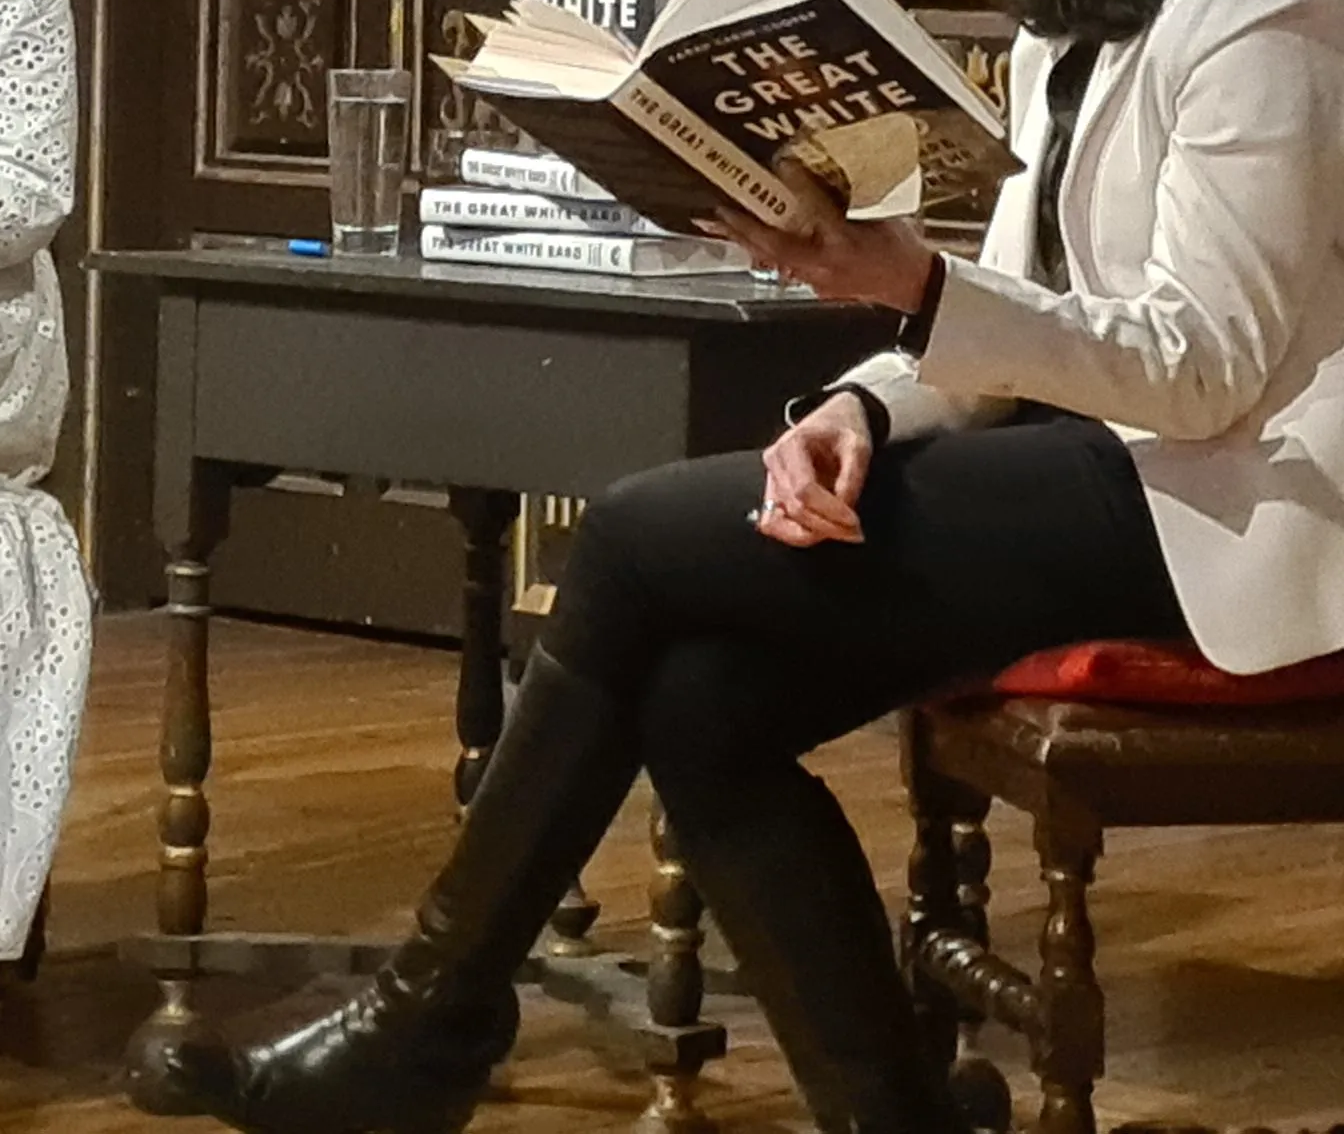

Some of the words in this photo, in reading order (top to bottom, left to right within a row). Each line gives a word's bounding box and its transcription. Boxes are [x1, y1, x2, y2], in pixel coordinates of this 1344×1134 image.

[711, 33, 820, 78] THE
[713, 51, 884, 116] GREAT
[743, 81, 918, 144] WHITE
[629, 87, 661, 118] THE
[659, 110, 705, 158] GREAT
[705, 149, 749, 191] WHITE
[749, 181, 788, 218] BARD
[434, 200, 462, 215] THE
[467, 202, 518, 218] GREAT
[524, 205, 573, 221] WHITE
[580, 208, 622, 223] BARD
[503, 242, 543, 258] WHITE
[548, 245, 582, 261] BARD
